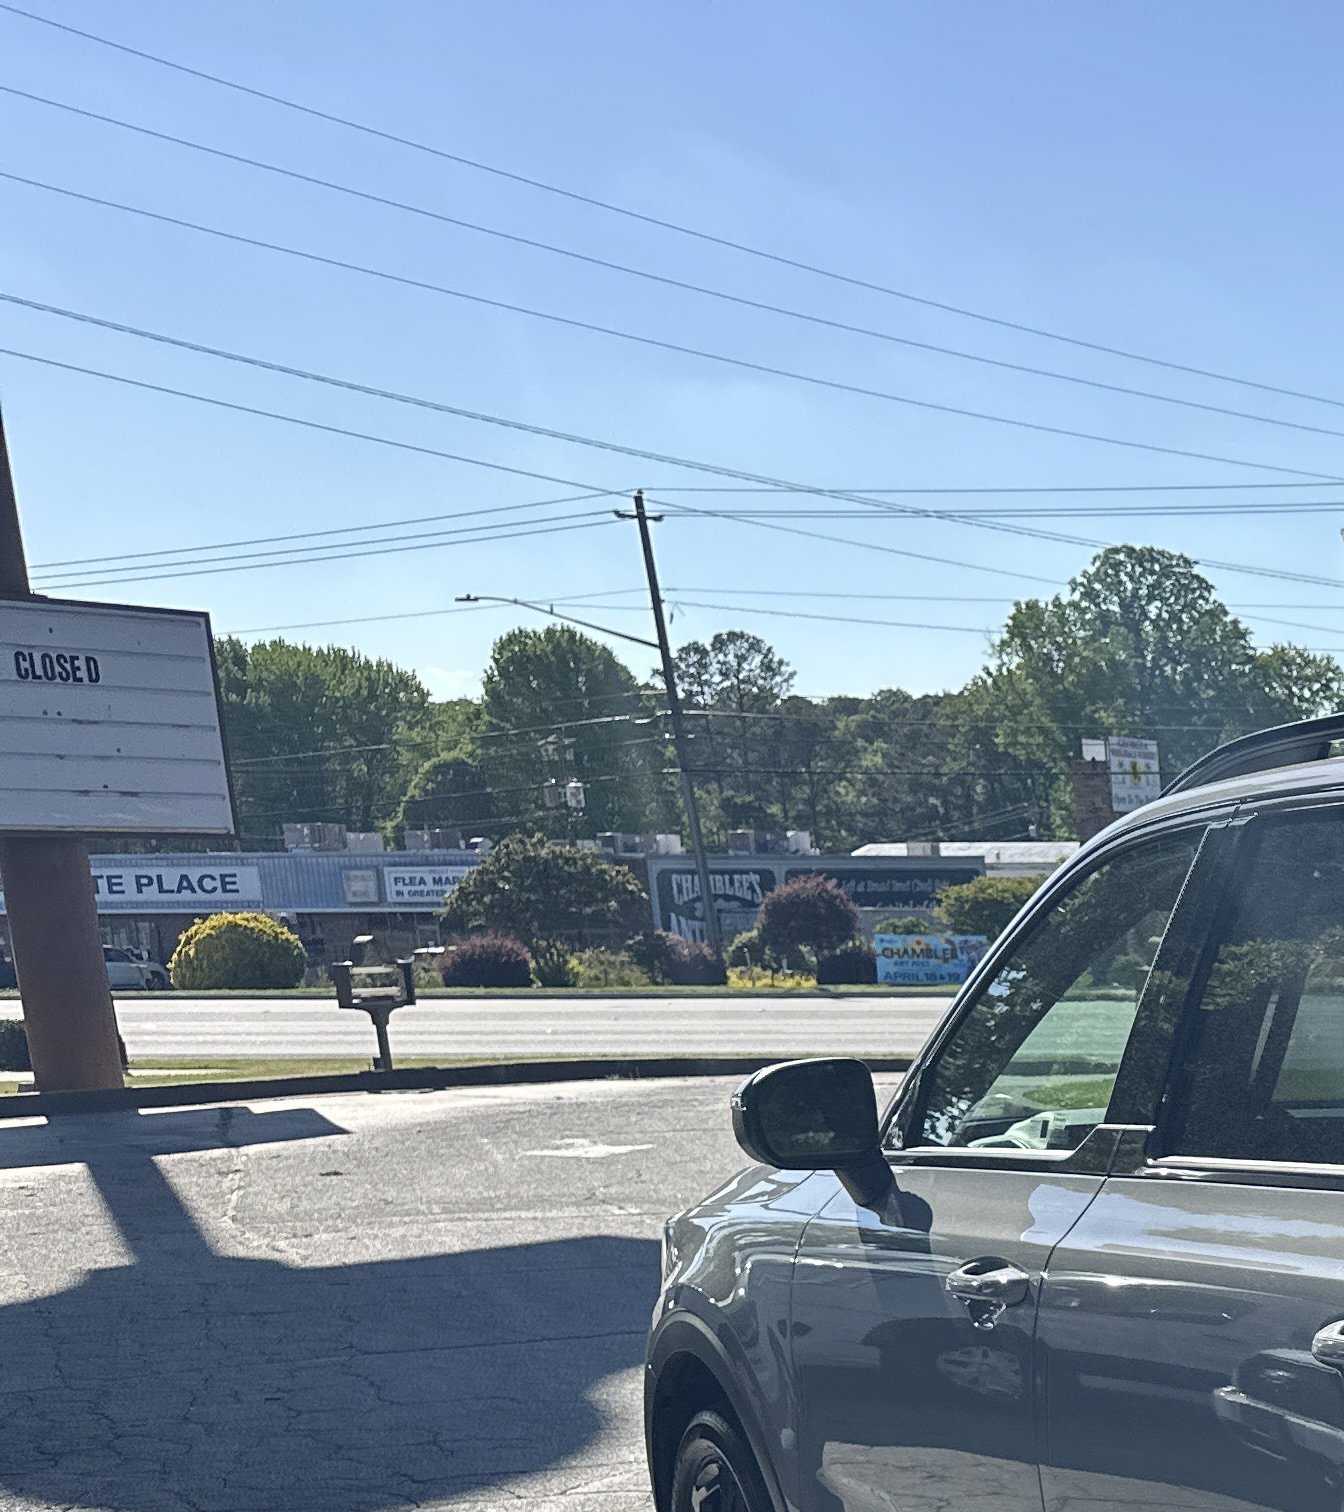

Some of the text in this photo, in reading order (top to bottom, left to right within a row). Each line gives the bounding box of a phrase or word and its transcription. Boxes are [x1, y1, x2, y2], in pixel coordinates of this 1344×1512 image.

[14, 651, 100, 683] CLOSED
[134, 872, 240, 894] PLACE
[393, 876, 427, 887] FLEA
[884, 971, 920, 981] APRIL
